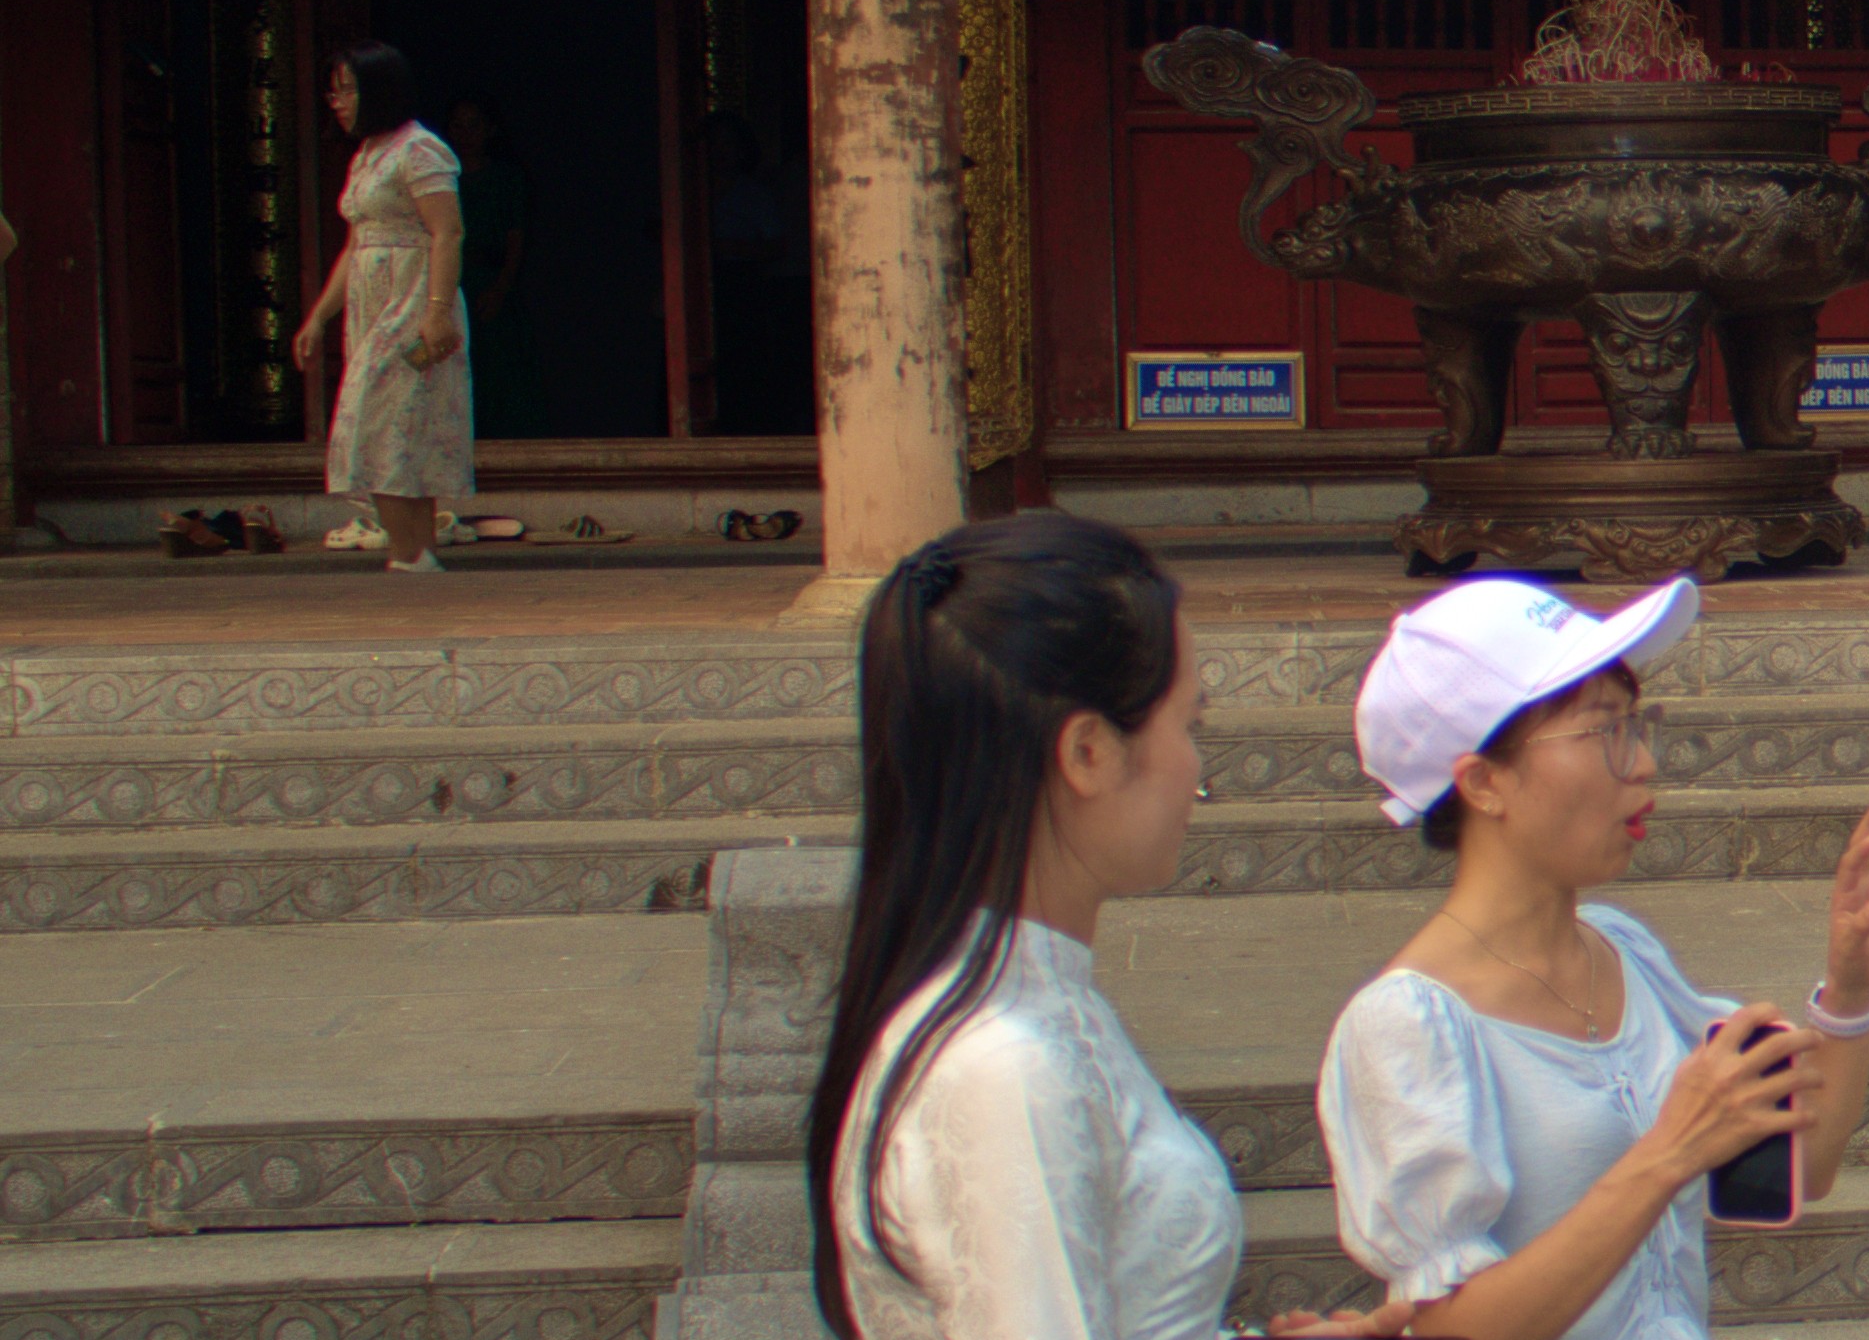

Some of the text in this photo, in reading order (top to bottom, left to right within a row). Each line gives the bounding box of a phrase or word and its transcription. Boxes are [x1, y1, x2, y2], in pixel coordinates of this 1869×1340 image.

[1176, 369, 1208, 390] NGHỊ
[1248, 367, 1275, 388] BÀO
[1221, 393, 1248, 414] BÊN
[1250, 393, 1291, 414] NGOÀI
[1827, 385, 1852, 406] BÊN
